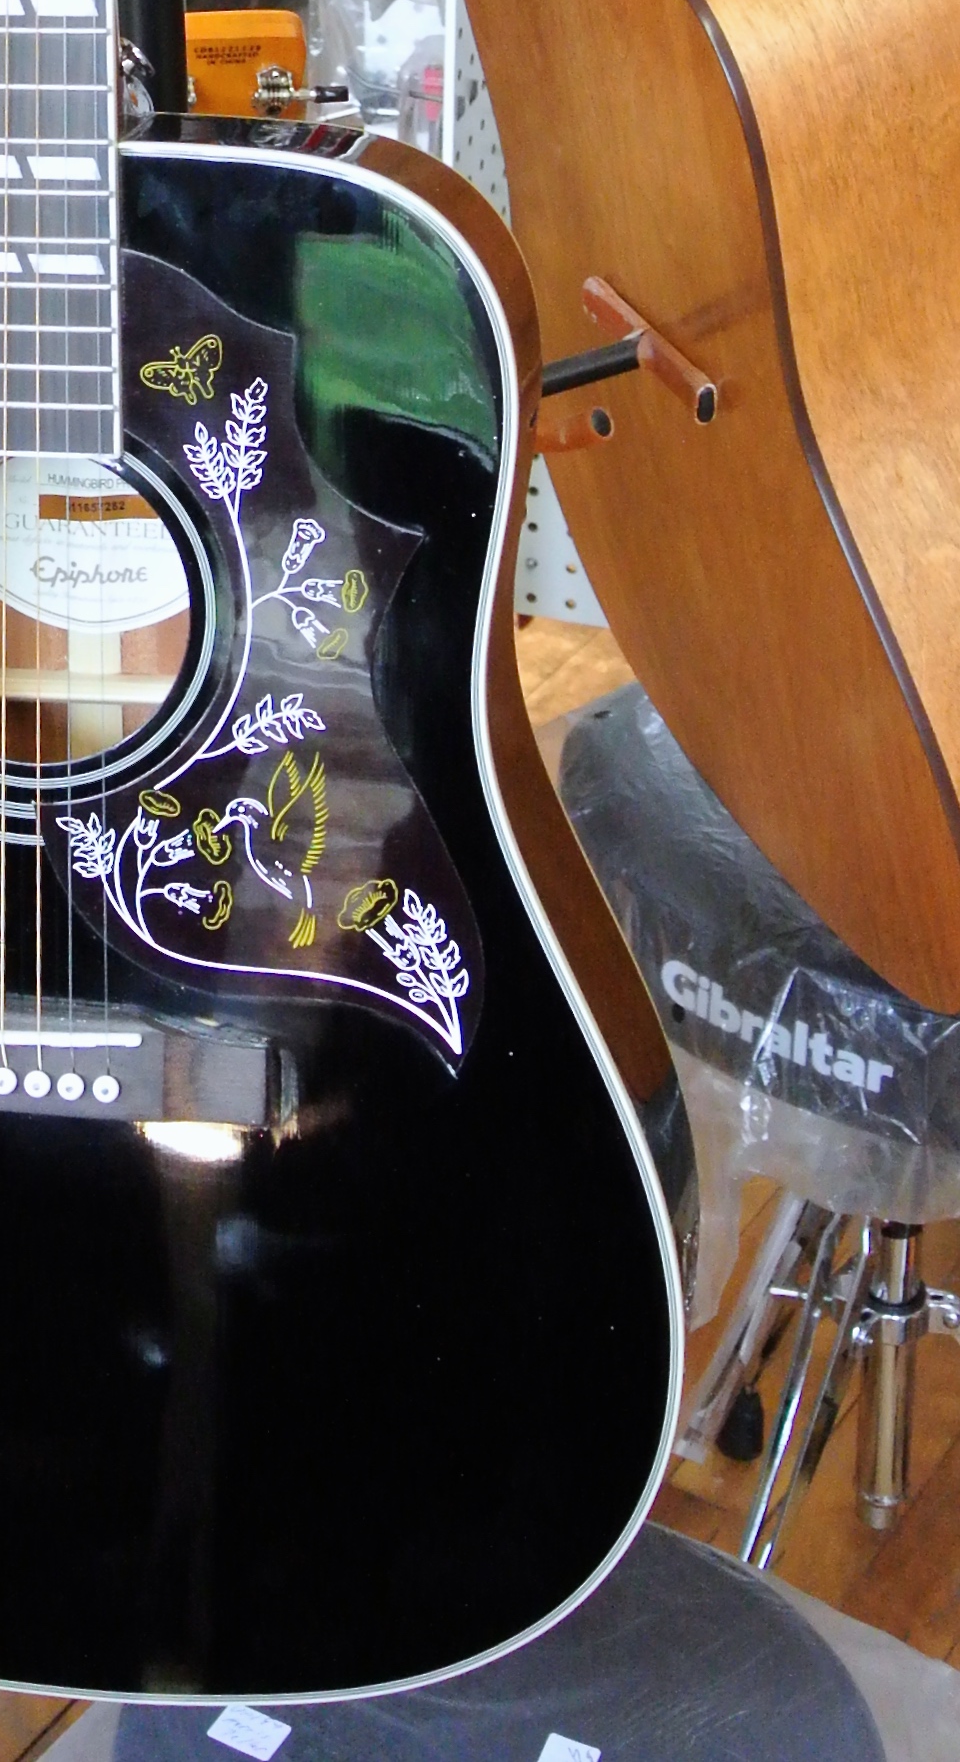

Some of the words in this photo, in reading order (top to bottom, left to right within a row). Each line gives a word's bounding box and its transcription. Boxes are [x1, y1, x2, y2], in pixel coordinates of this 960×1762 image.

[47, 473, 114, 489] HUMMINGBIRD
[29, 556, 148, 588] Epiphone
[661, 960, 894, 1094] Gibraltar
